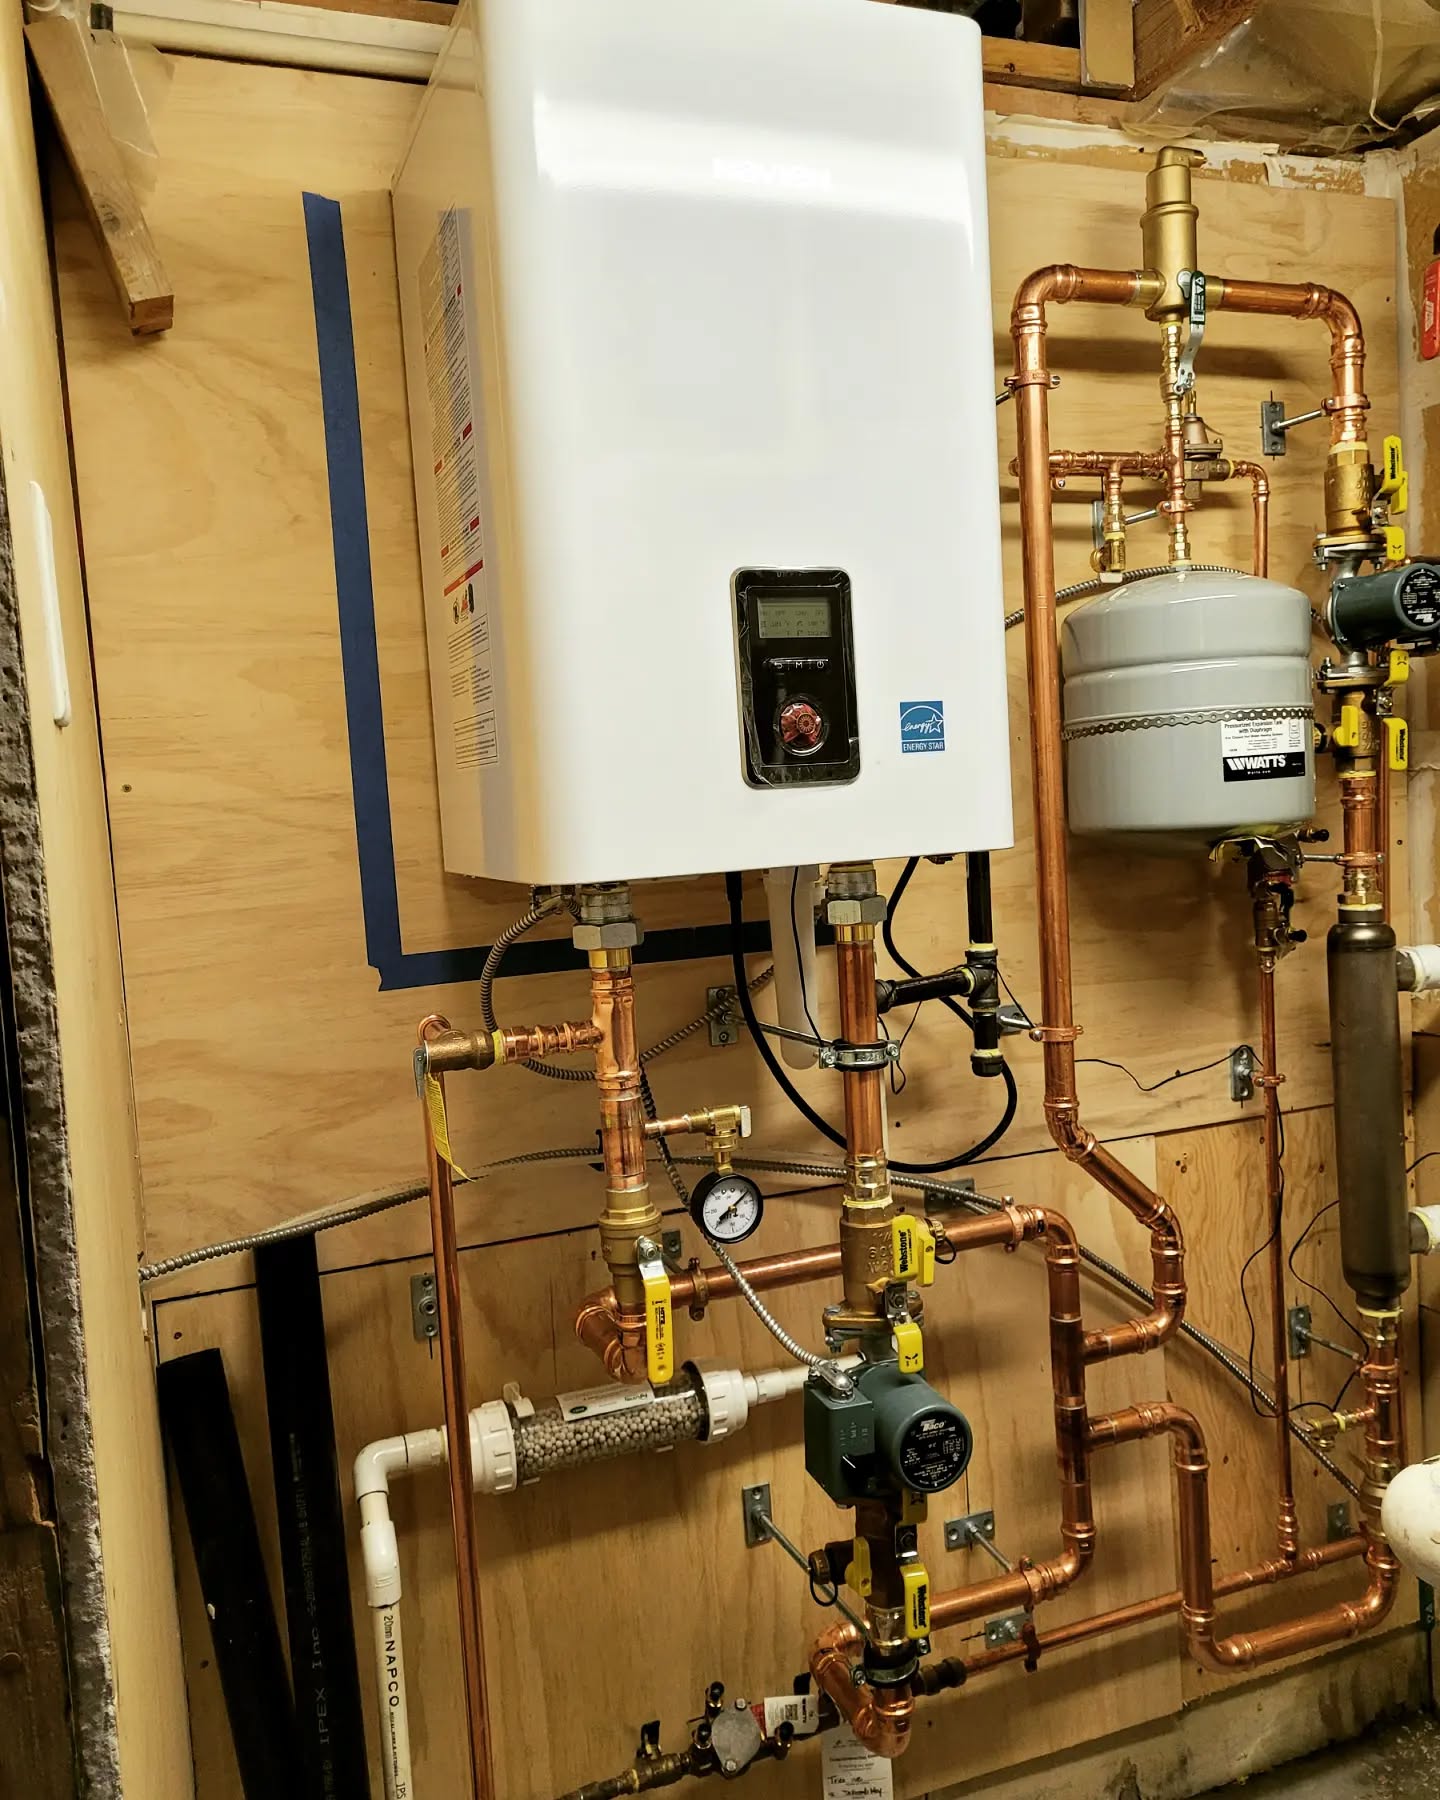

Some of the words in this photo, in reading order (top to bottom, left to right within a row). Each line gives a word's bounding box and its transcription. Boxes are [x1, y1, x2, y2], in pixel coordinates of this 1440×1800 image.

[903, 743, 928, 752] ENERGY
[929, 741, 944, 750] STAR
[1244, 755, 1286, 770] WATTS
[899, 1231, 908, 1273] Webstone
[921, 1419, 945, 1432] Taco
[384, 1615, 393, 1638] 20mm
[385, 1640, 399, 1707] NAPCO
[314, 1687, 330, 1745] IPEX
